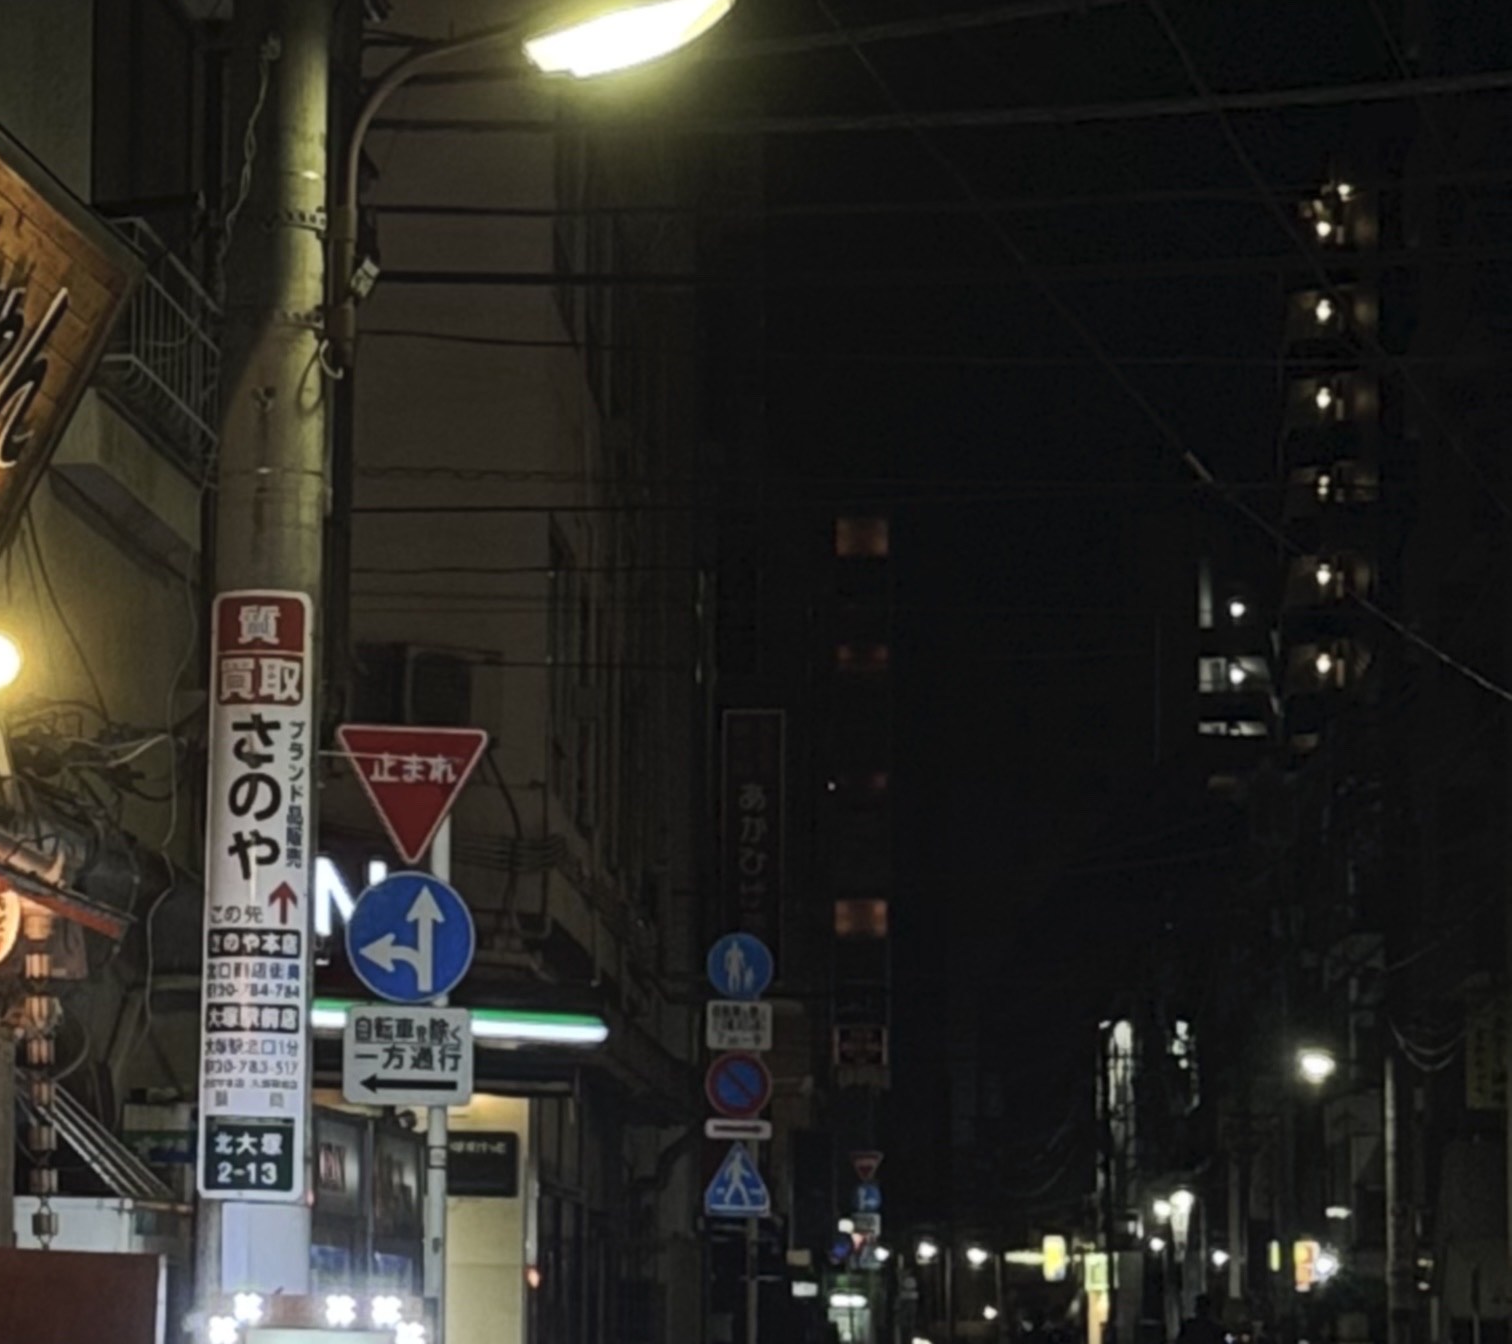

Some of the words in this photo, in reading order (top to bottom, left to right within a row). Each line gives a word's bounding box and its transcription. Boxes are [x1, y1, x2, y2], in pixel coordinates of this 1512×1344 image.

[239, 605, 281, 645] 質
[220, 657, 300, 702] 買取
[370, 752, 457, 784] 止まれ
[228, 713, 282, 881] さのや
[210, 906, 263, 924] この先
[354, 1044, 462, 1072] 一方通行
[214, 1131, 283, 1155] 北大塚
[217, 1162, 278, 1185] 2-13
